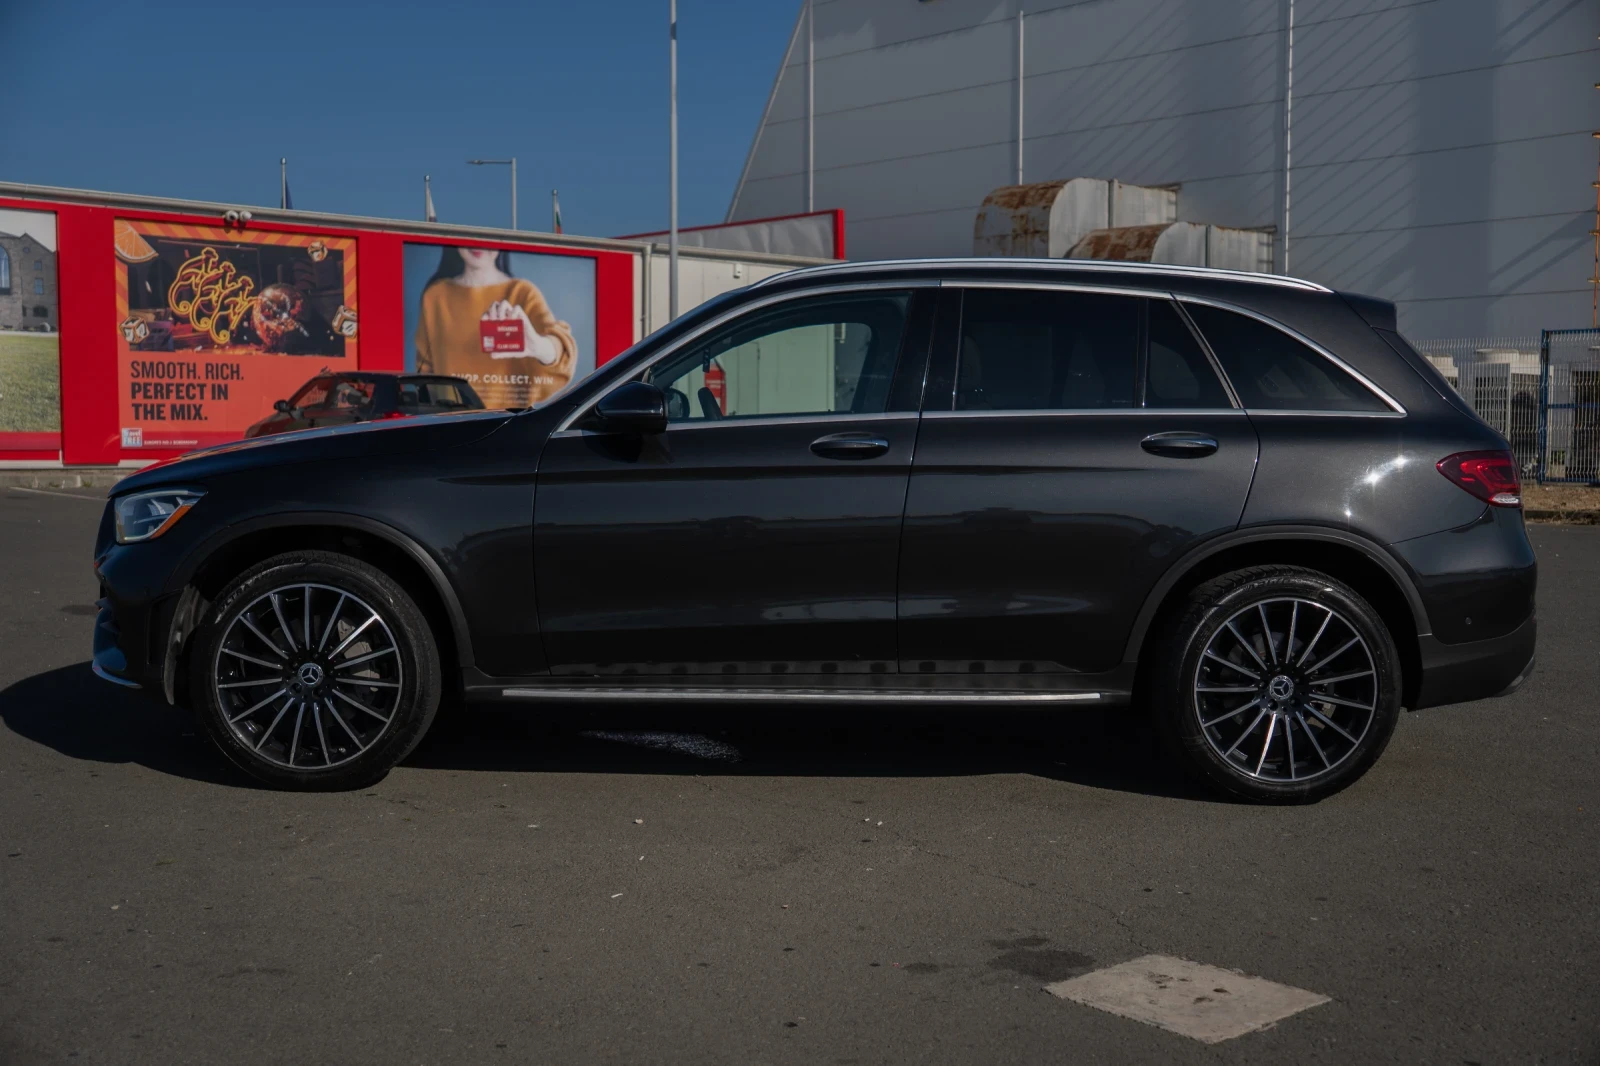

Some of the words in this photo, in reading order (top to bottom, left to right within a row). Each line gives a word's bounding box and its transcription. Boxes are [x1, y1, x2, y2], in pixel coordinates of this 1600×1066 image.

[130, 360, 201, 380] SMOOTH.
[205, 362, 244, 381] RICH.
[483, 374, 532, 385] COLLECT.
[533, 375, 554, 385] WIN
[130, 381, 207, 400] PERFECT
[211, 383, 229, 401] IN
[131, 402, 166, 421] THE
[170, 403, 208, 421] MIX.
[123, 436, 141, 445] FREE
